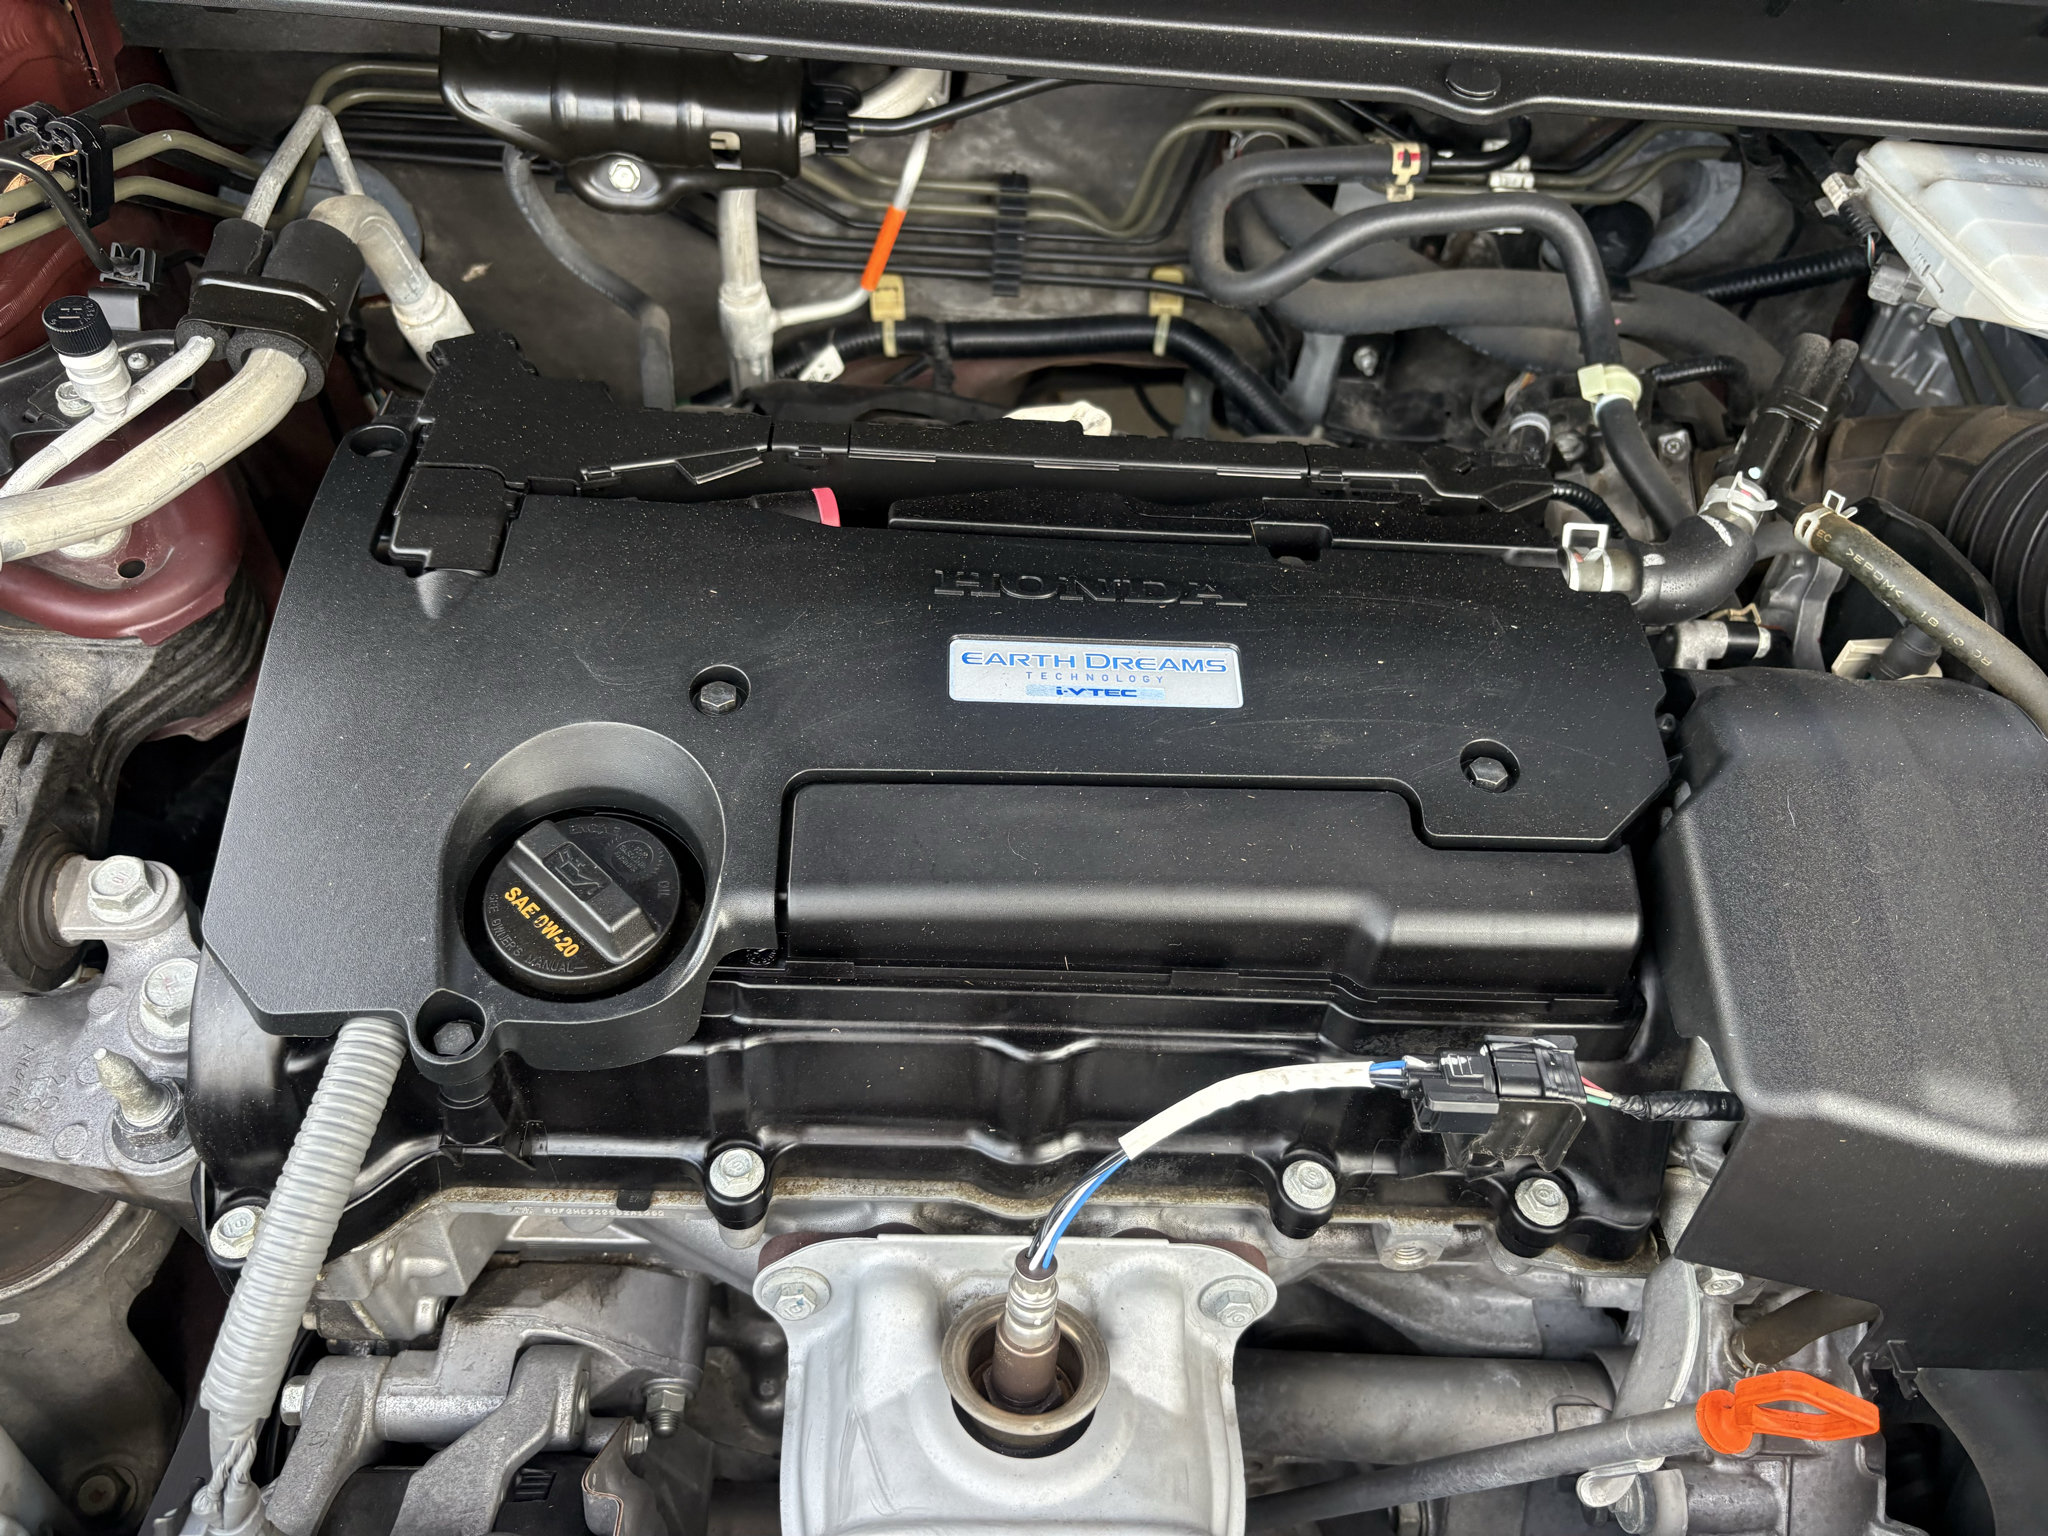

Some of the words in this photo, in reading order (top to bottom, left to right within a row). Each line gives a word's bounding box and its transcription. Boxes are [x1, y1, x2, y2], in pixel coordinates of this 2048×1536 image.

[933, 568, 1248, 607] HONDA
[1921, 611, 1939, 628] 18
[961, 651, 1075, 669] EARTH
[1084, 653, 1227, 673] DREAMS
[1025, 671, 1165, 684] TECHNOLOGY
[1055, 685, 1138, 698] i-VTEC
[504, 886, 541, 920] SAE
[533, 914, 580, 958] 0W-20
